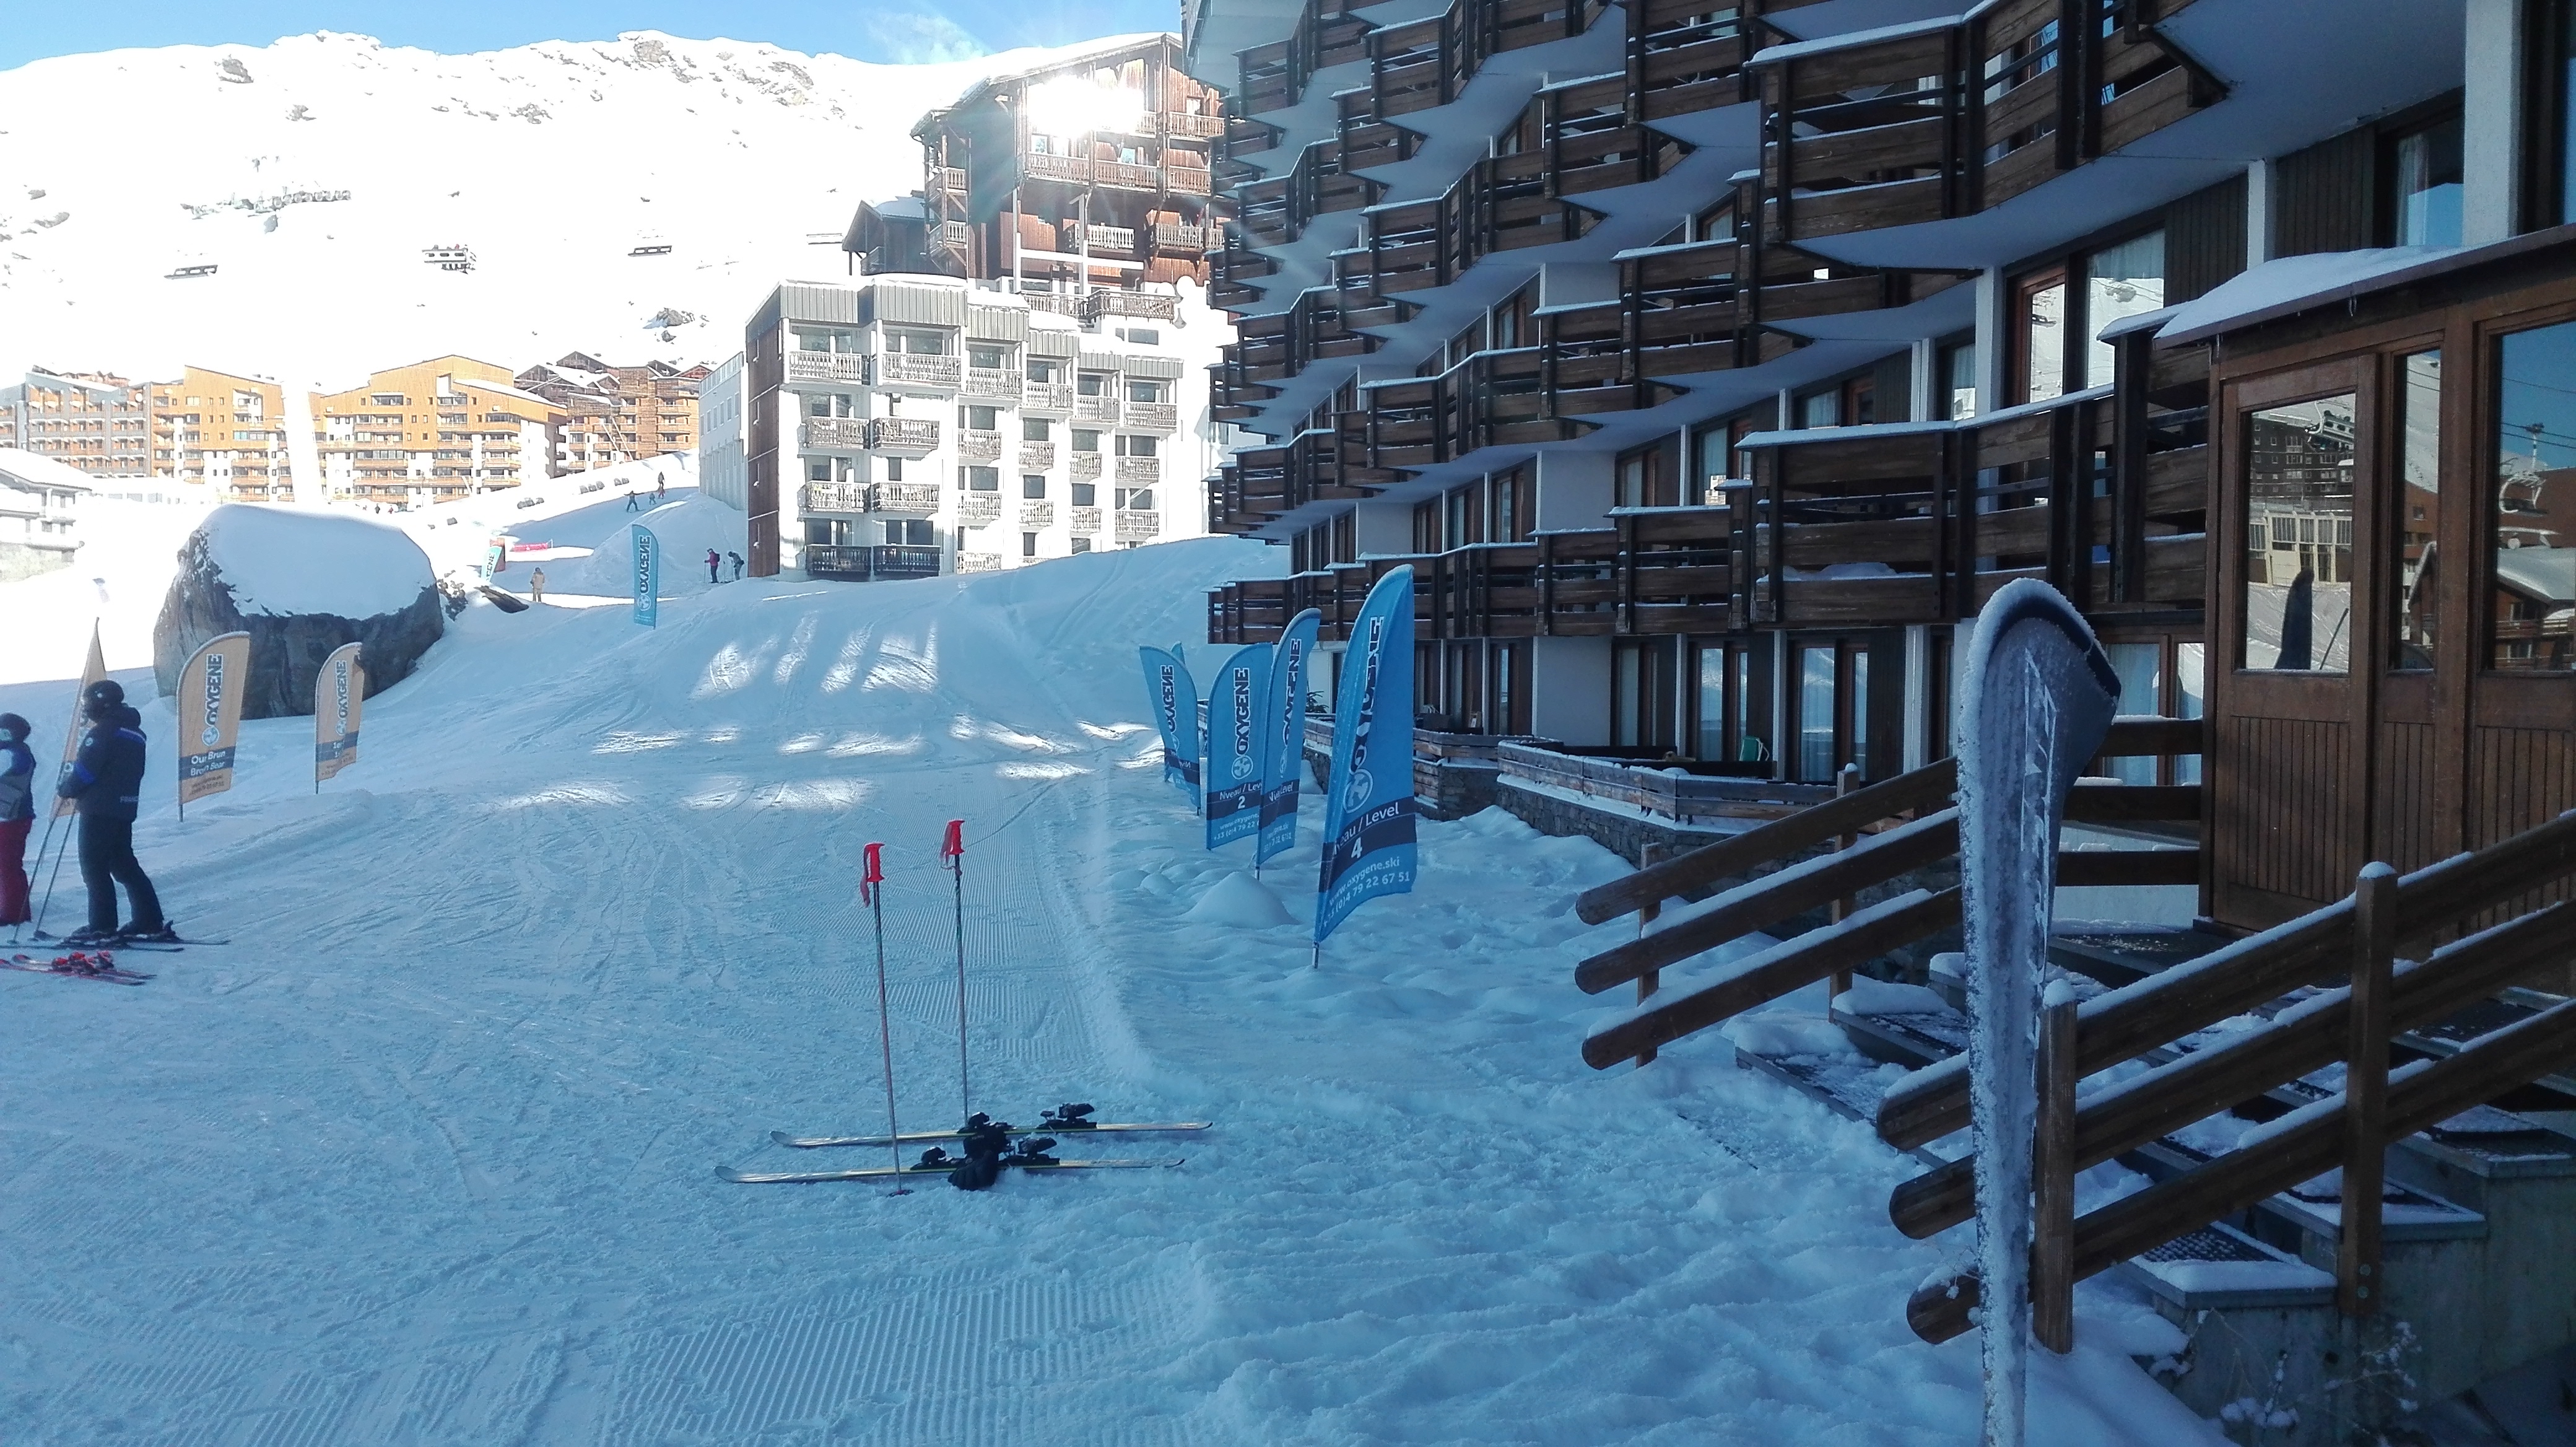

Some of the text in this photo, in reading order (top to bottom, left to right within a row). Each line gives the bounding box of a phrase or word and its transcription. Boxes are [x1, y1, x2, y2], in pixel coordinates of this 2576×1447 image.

[204, 654, 223, 726] OXYGENE
[335, 660, 347, 719] OXYGENE
[1234, 668, 1250, 756] OXYGENE
[207, 751, 225, 760] Brun
[1238, 795, 1246, 809] 2
[1366, 802, 1399, 827] Level
[1351, 837, 1363, 859] 4
[1352, 884, 1363, 898] 79
[1365, 876, 1379, 889] 22
[1382, 872, 1395, 885] 67
[1398, 870, 1410, 882] 51
